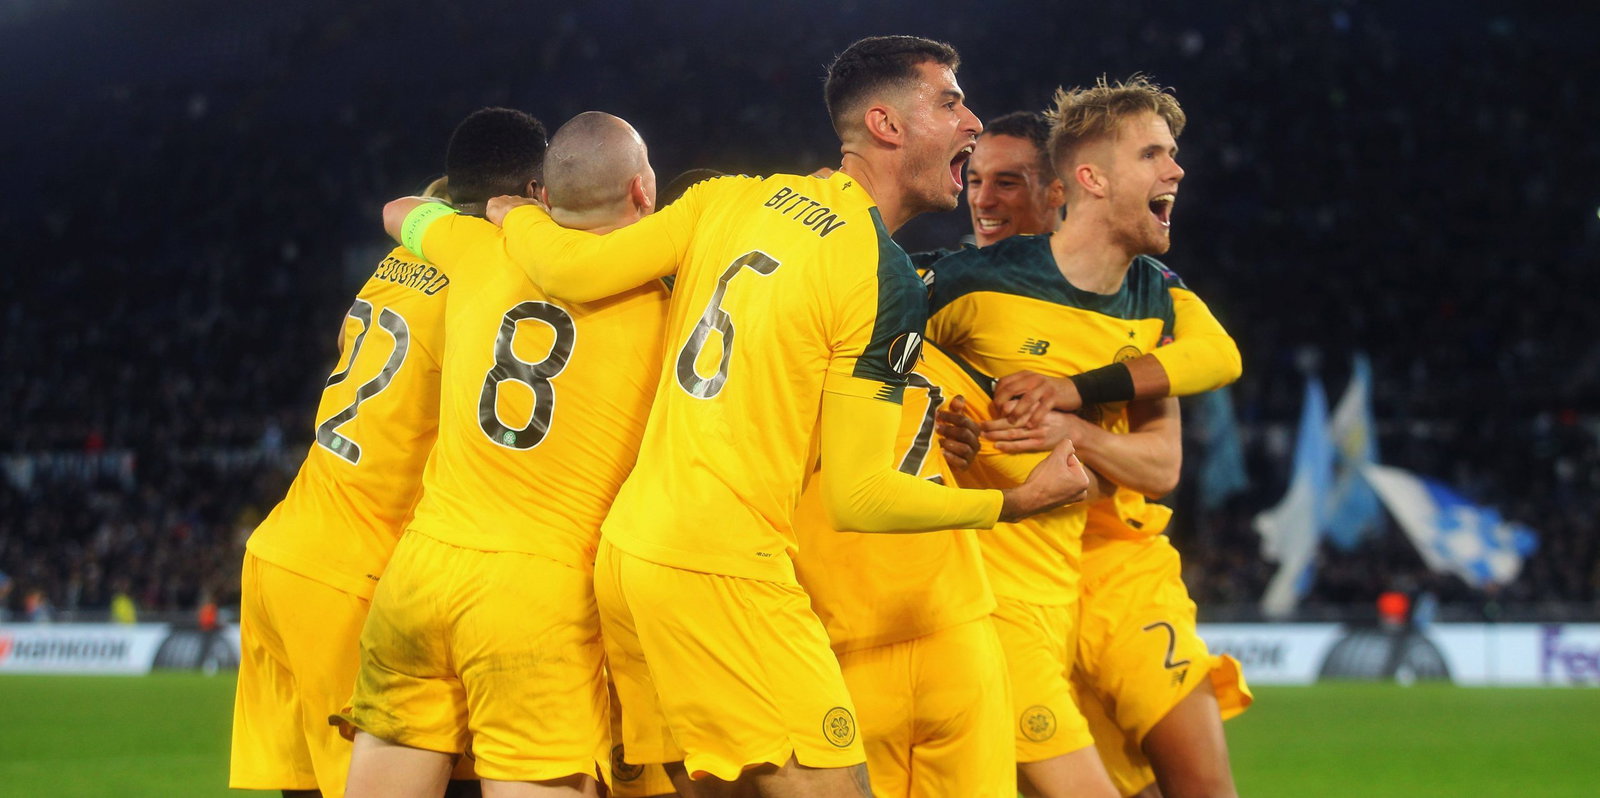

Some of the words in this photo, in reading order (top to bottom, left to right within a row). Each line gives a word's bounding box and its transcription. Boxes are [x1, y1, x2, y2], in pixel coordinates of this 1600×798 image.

[763, 186, 846, 238] BITTON
[315, 298, 411, 465] 22
[478, 300, 577, 450] 8
[675, 249, 782, 400] 6
[1143, 621, 1191, 669] 2
